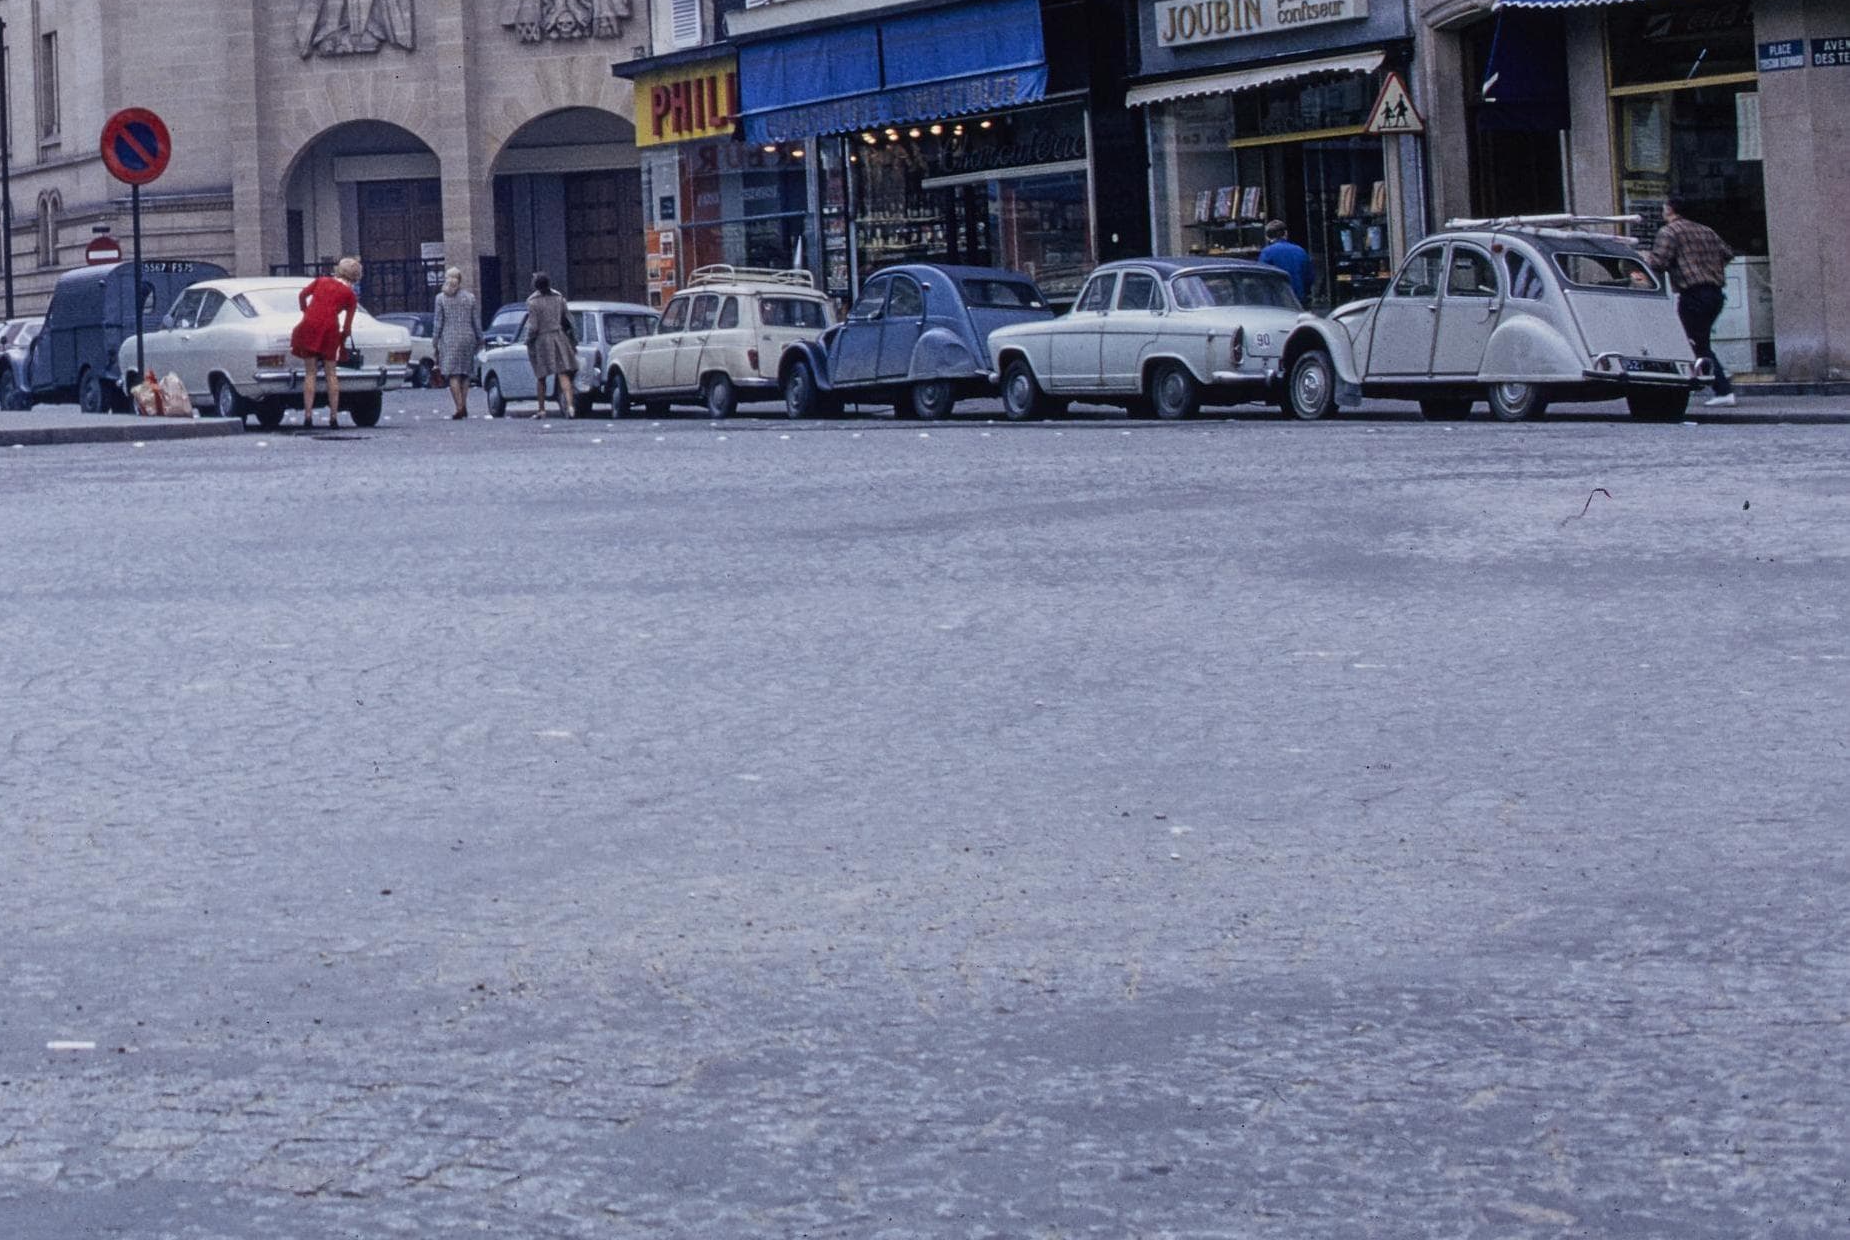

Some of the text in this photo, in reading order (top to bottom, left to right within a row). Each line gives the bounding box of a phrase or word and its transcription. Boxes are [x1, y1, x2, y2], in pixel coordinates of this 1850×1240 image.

[1769, 43, 1792, 56] PLACE
[1814, 54, 1835, 65] DES
[1257, 333, 1271, 347] 90
